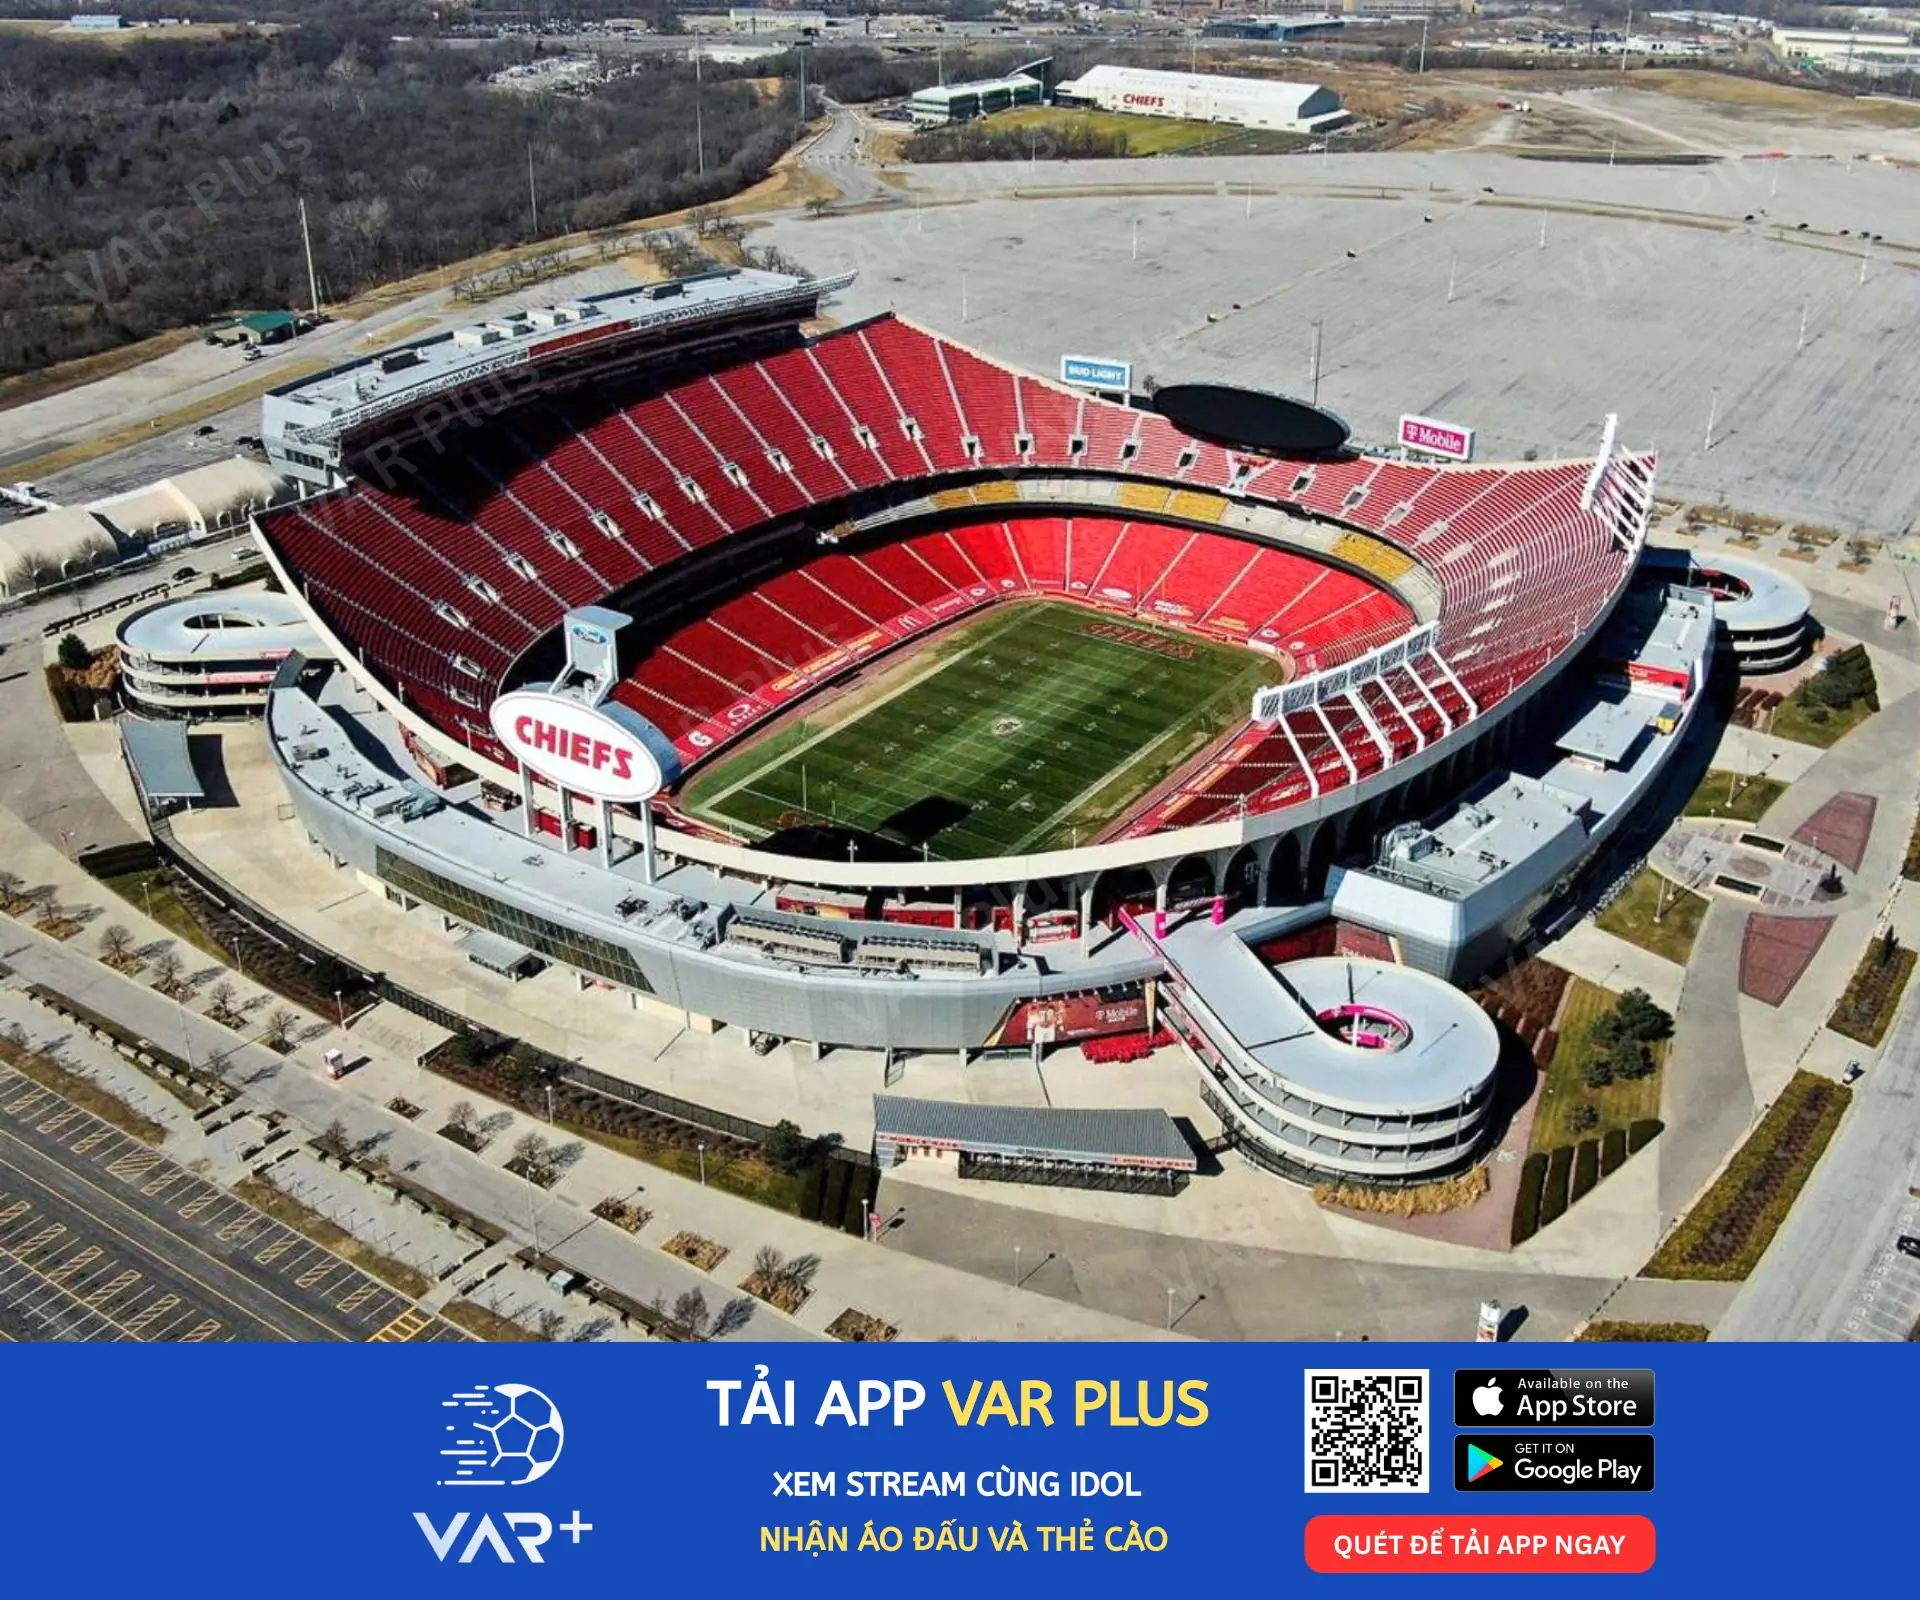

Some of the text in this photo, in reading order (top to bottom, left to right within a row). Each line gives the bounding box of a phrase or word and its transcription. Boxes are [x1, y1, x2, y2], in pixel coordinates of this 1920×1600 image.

[1122, 93, 1165, 108] CHIEFS
[1068, 365, 1124, 381] BUD LIGHT
[1419, 428, 1462, 451] Mobile
[514, 714, 634, 781] CHIEFS
